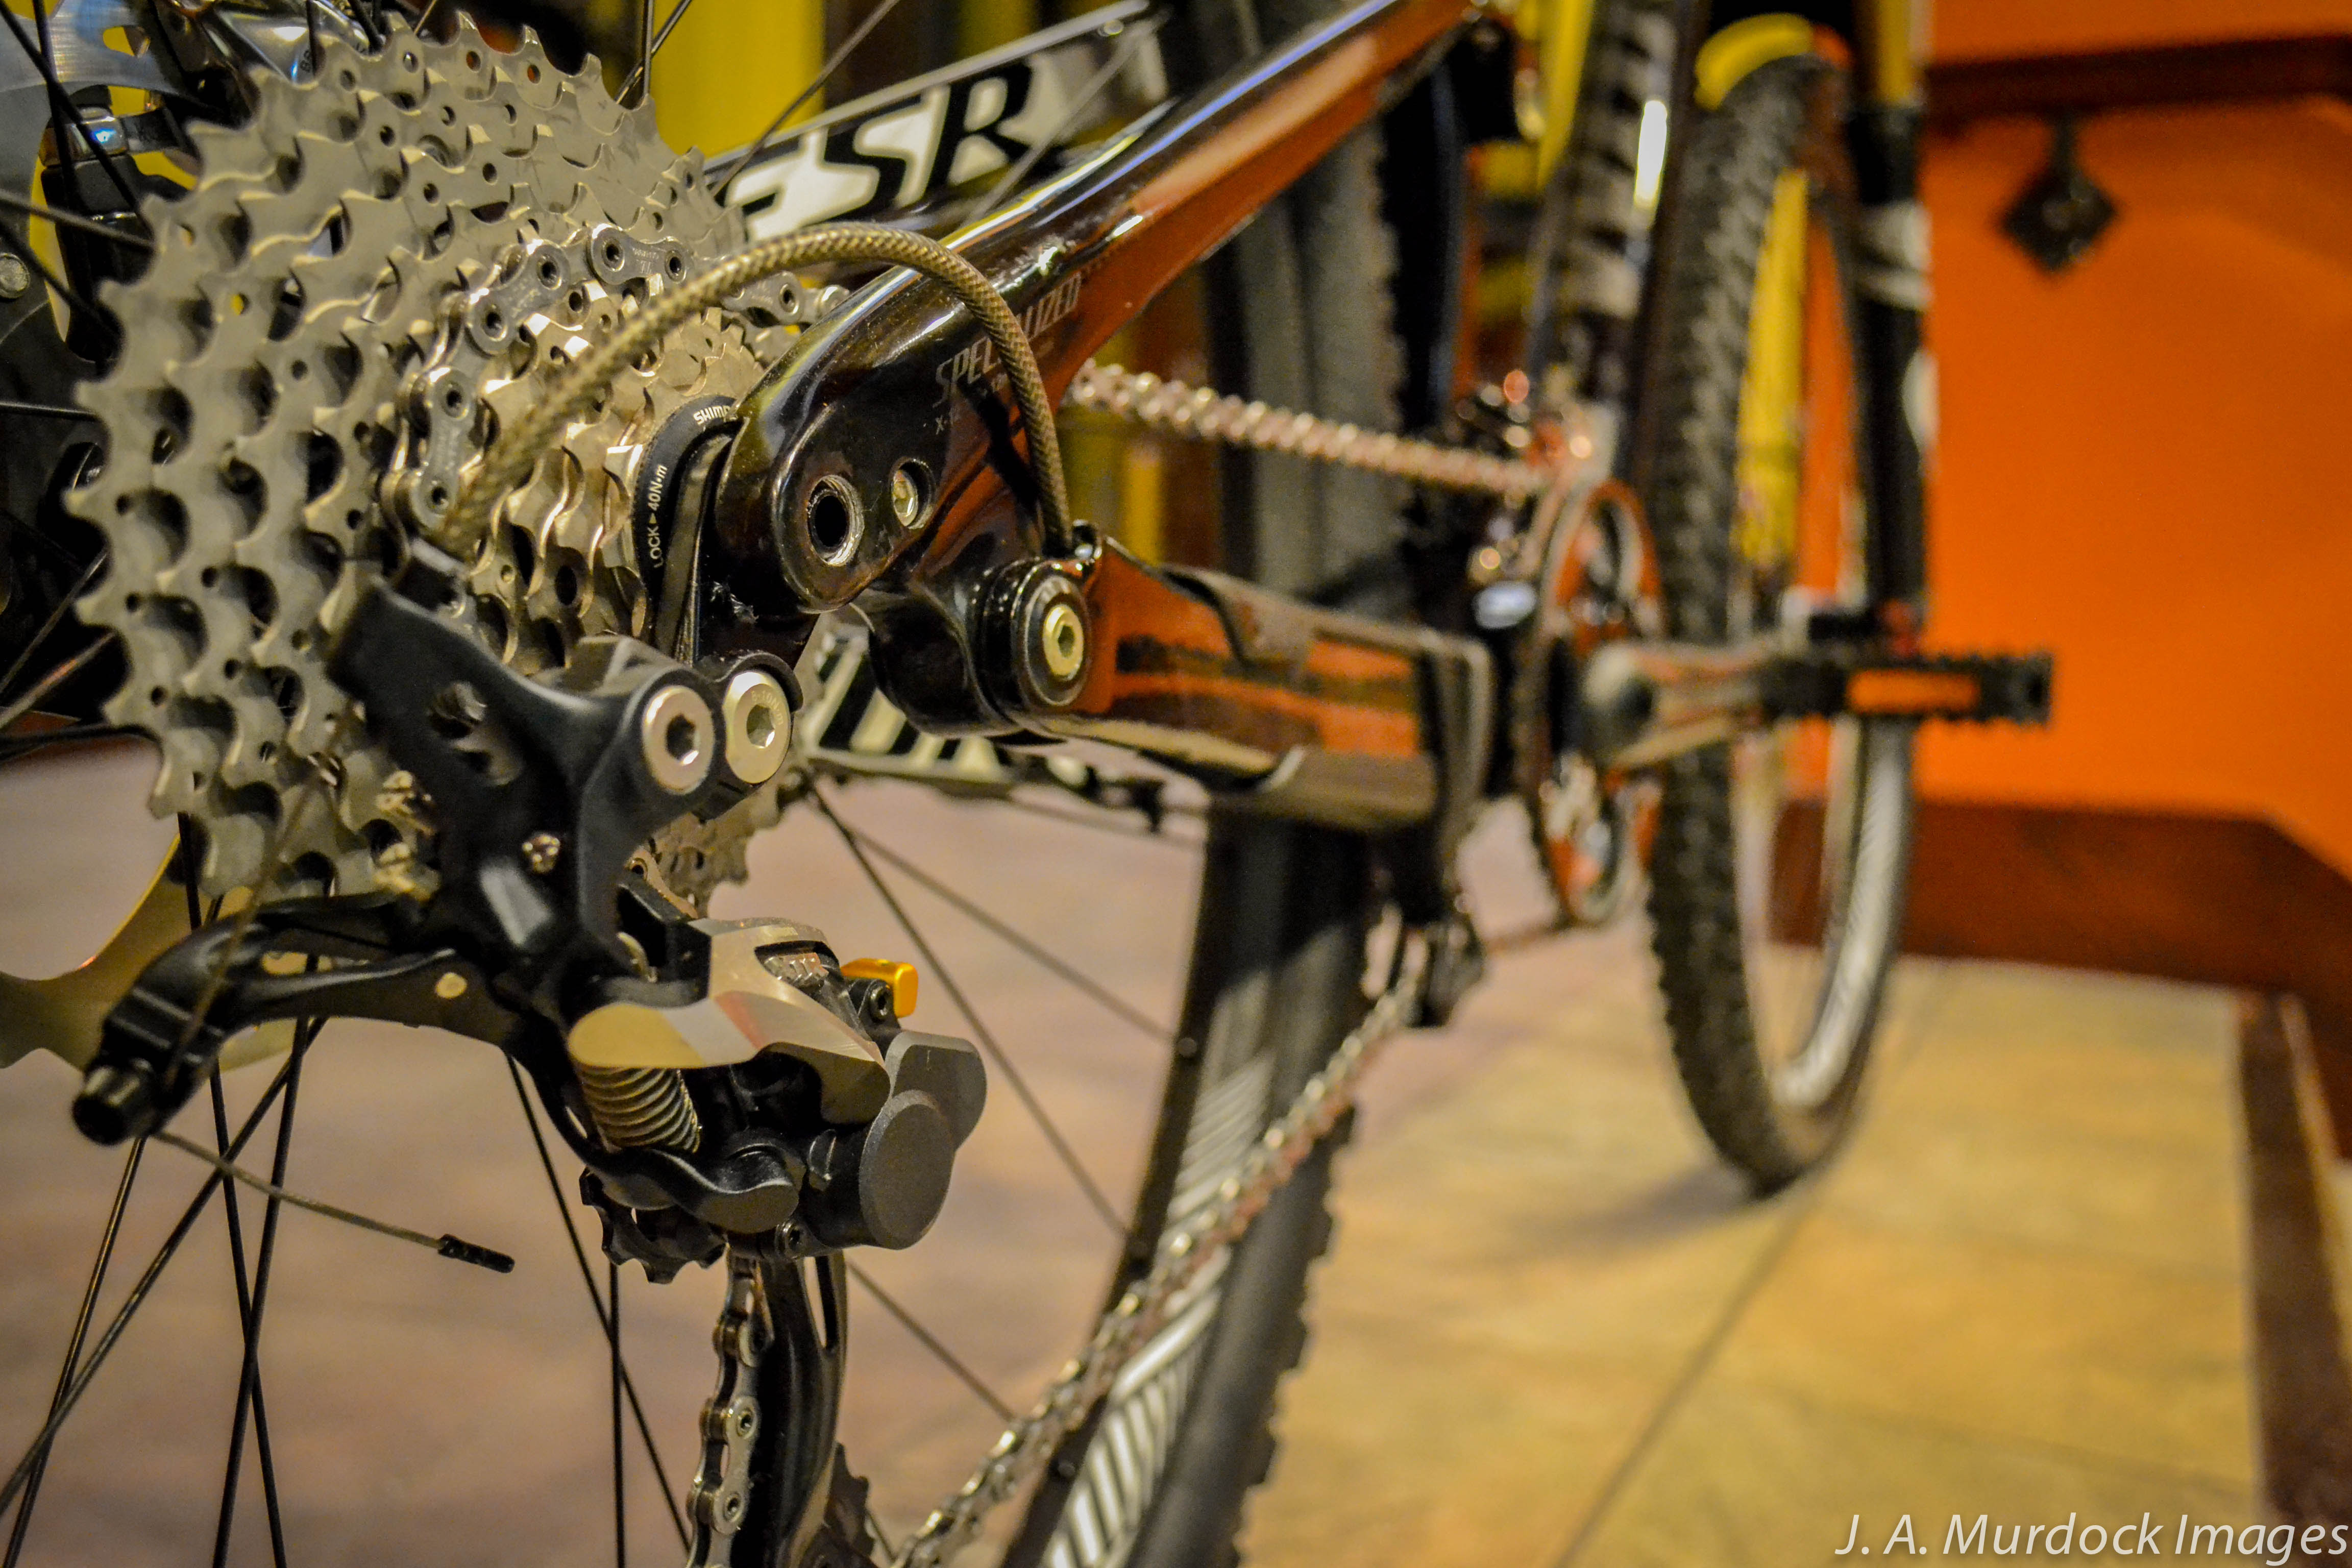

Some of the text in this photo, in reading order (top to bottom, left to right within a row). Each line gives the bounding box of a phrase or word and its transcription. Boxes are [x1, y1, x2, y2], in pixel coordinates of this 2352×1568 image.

[933, 272, 1082, 408] SPECLIZED
[693, 405, 731, 425] SHIMA
[647, 526, 663, 568] LOCK
